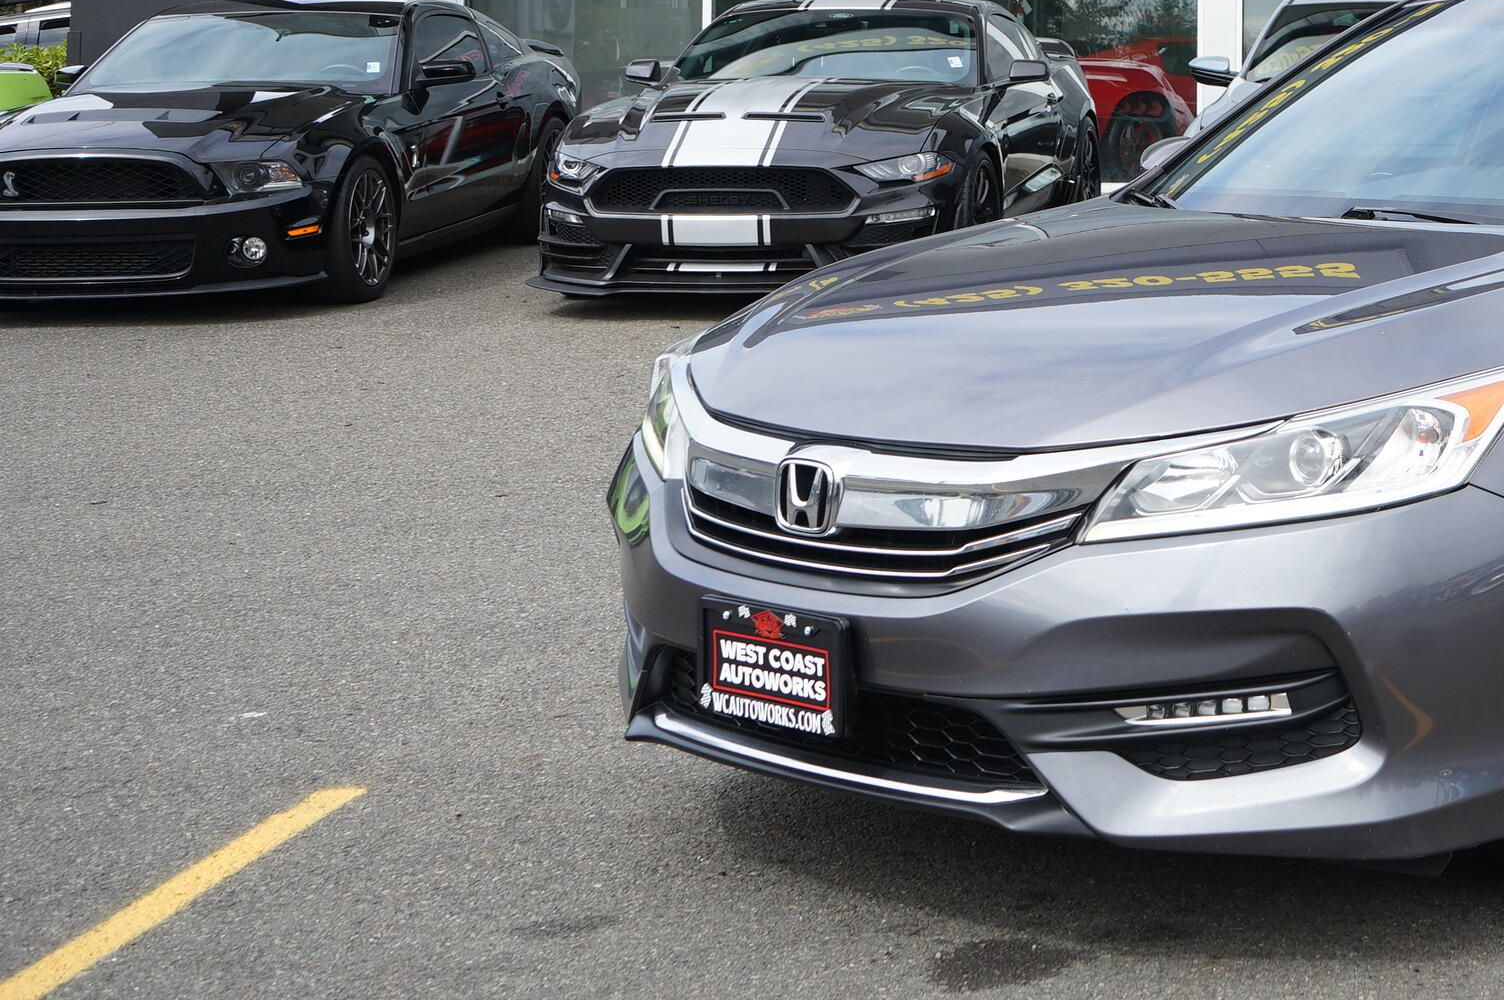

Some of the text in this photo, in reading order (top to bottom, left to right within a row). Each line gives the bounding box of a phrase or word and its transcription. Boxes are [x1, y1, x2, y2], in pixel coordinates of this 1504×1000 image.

[720, 639, 825, 677] WEST COAST
[719, 662, 827, 702] AUTOWORKS
[711, 691, 823, 734] WCAUTOWORKS.COM
